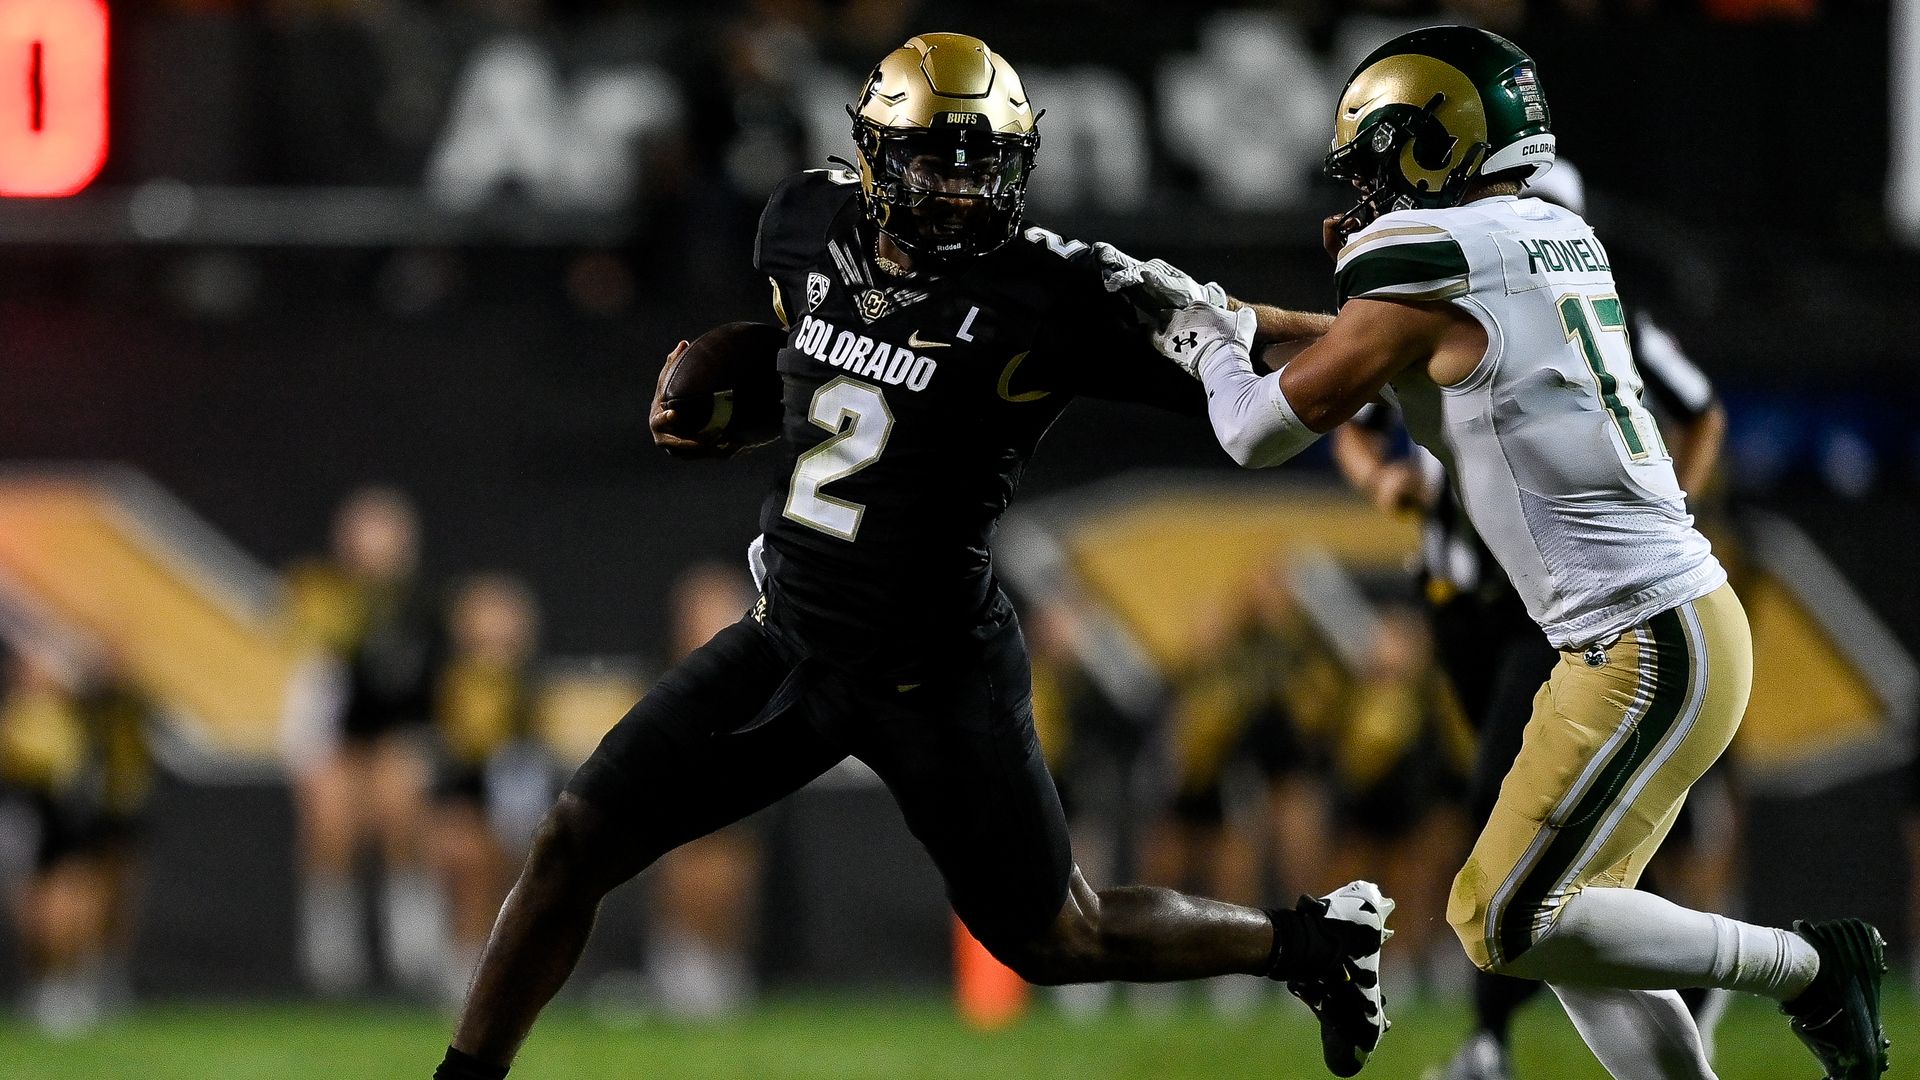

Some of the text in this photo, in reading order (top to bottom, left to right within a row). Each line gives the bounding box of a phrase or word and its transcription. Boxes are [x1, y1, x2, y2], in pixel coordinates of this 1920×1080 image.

[946, 112, 978, 125] BUFFS
[936, 242, 962, 251] Riddell
[1024, 226, 1091, 259] 2
[807, 274, 830, 298] PAC
[809, 289, 821, 305] 12
[956, 306, 980, 342] L
[794, 315, 938, 392] COLORADO
[782, 374, 896, 543] 2
